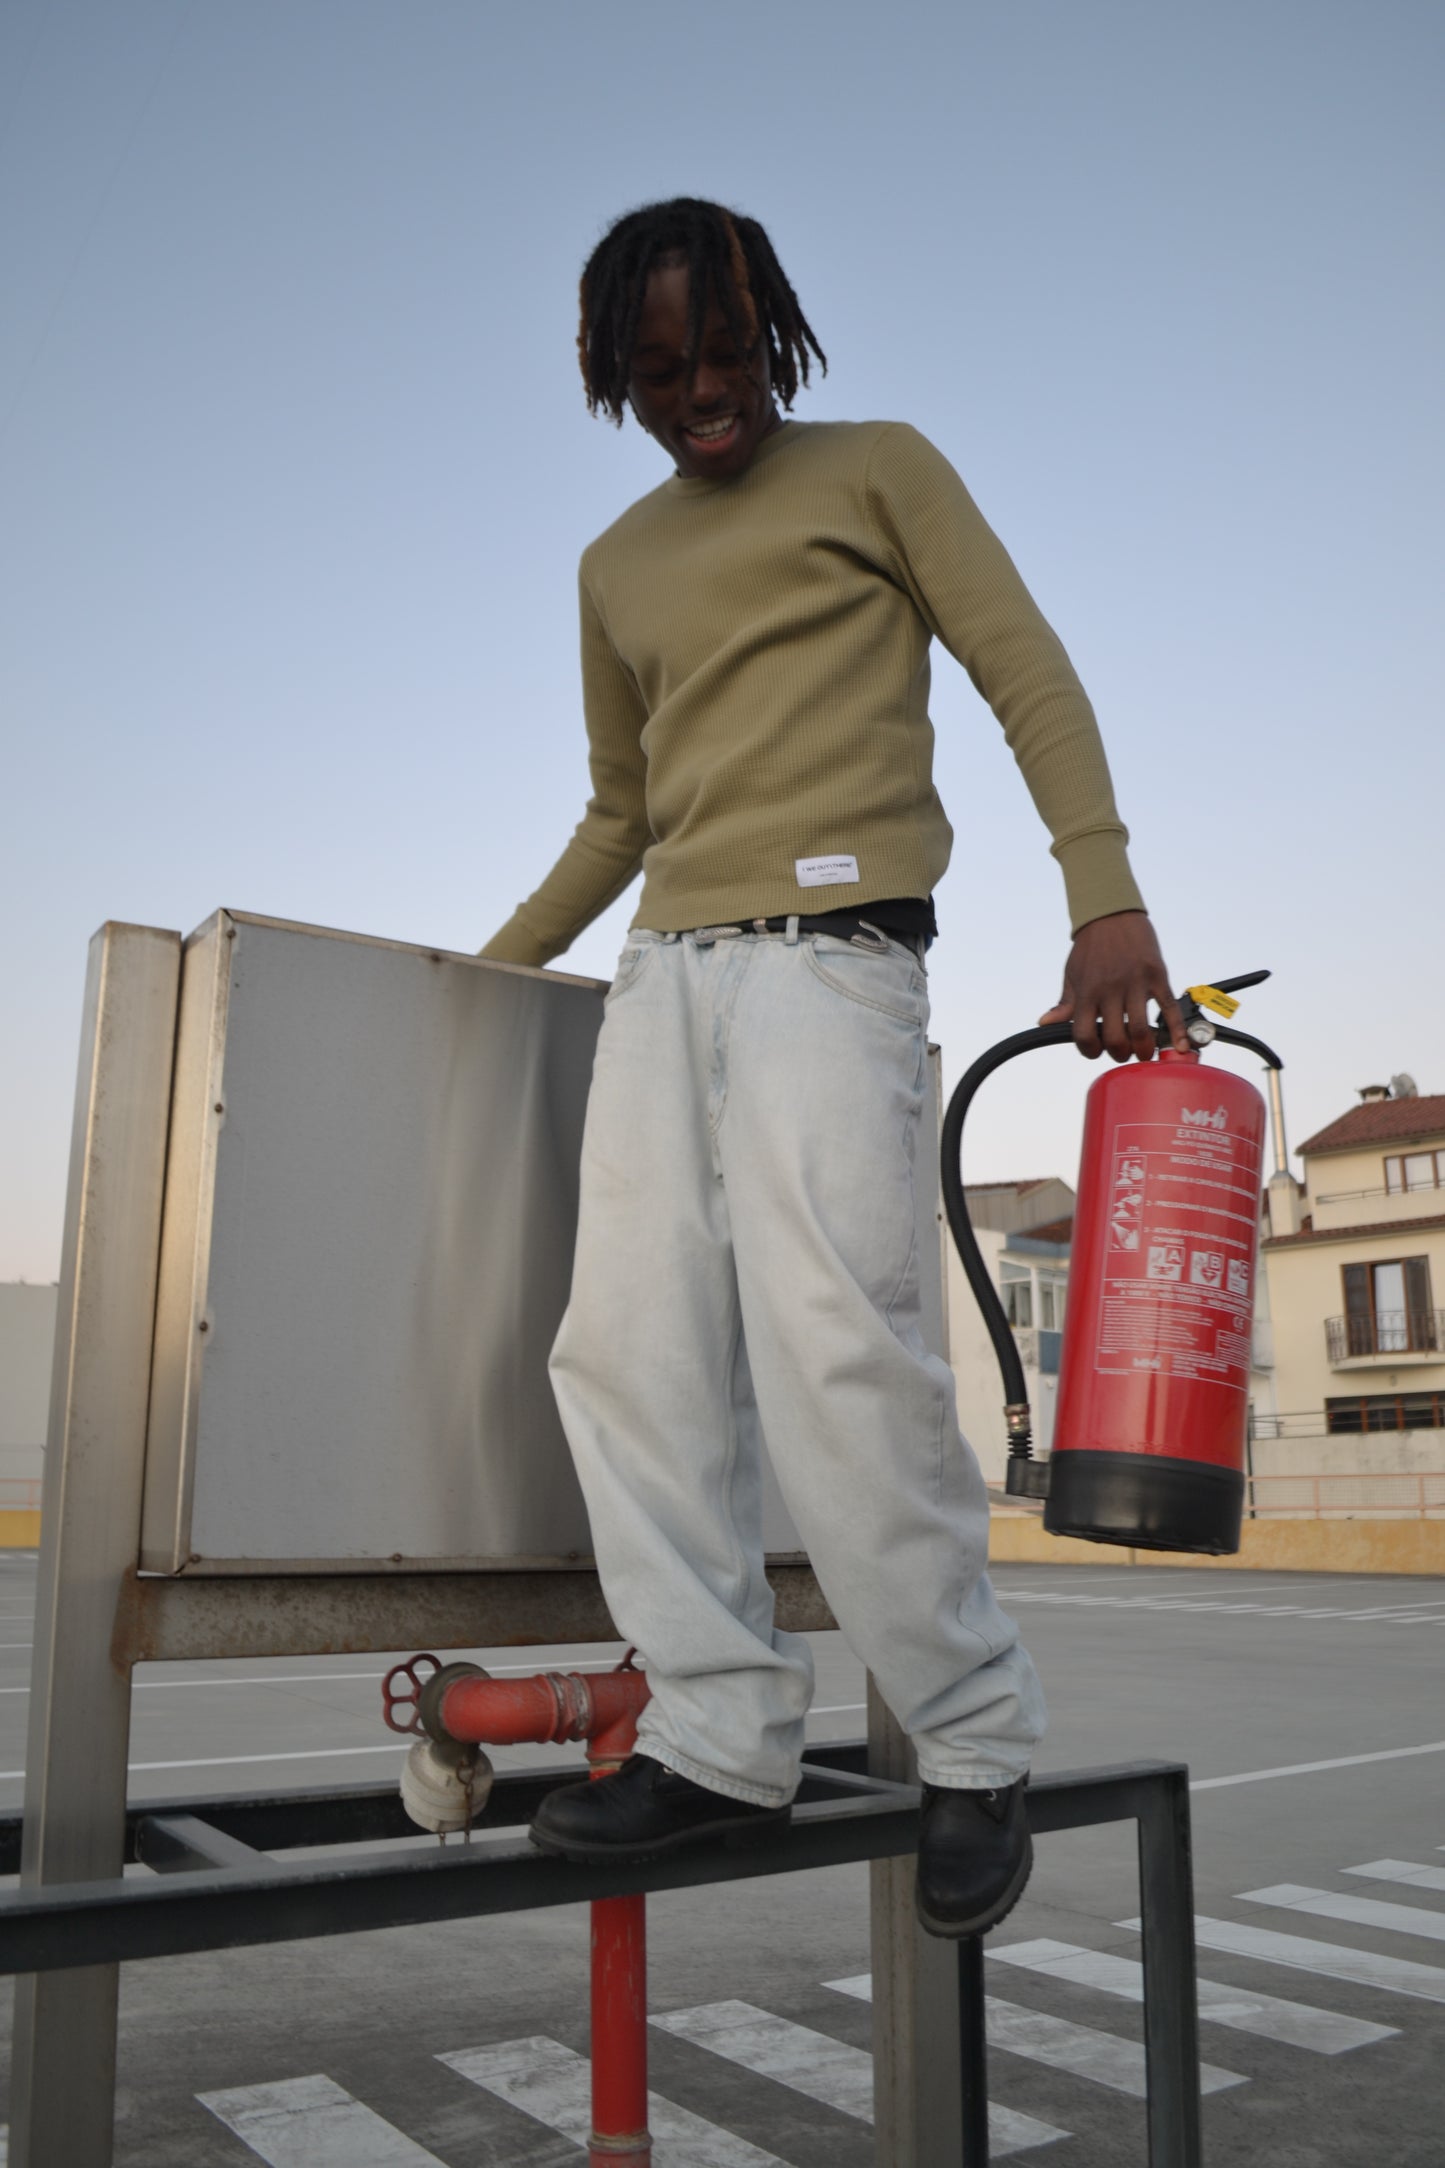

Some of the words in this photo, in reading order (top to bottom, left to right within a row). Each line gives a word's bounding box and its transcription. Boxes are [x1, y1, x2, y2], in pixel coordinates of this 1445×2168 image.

[1176, 1129, 1231, 1146] EXTINTOR
[1168, 1249, 1181, 1264] A
[1210, 1255, 1222, 1271] B
